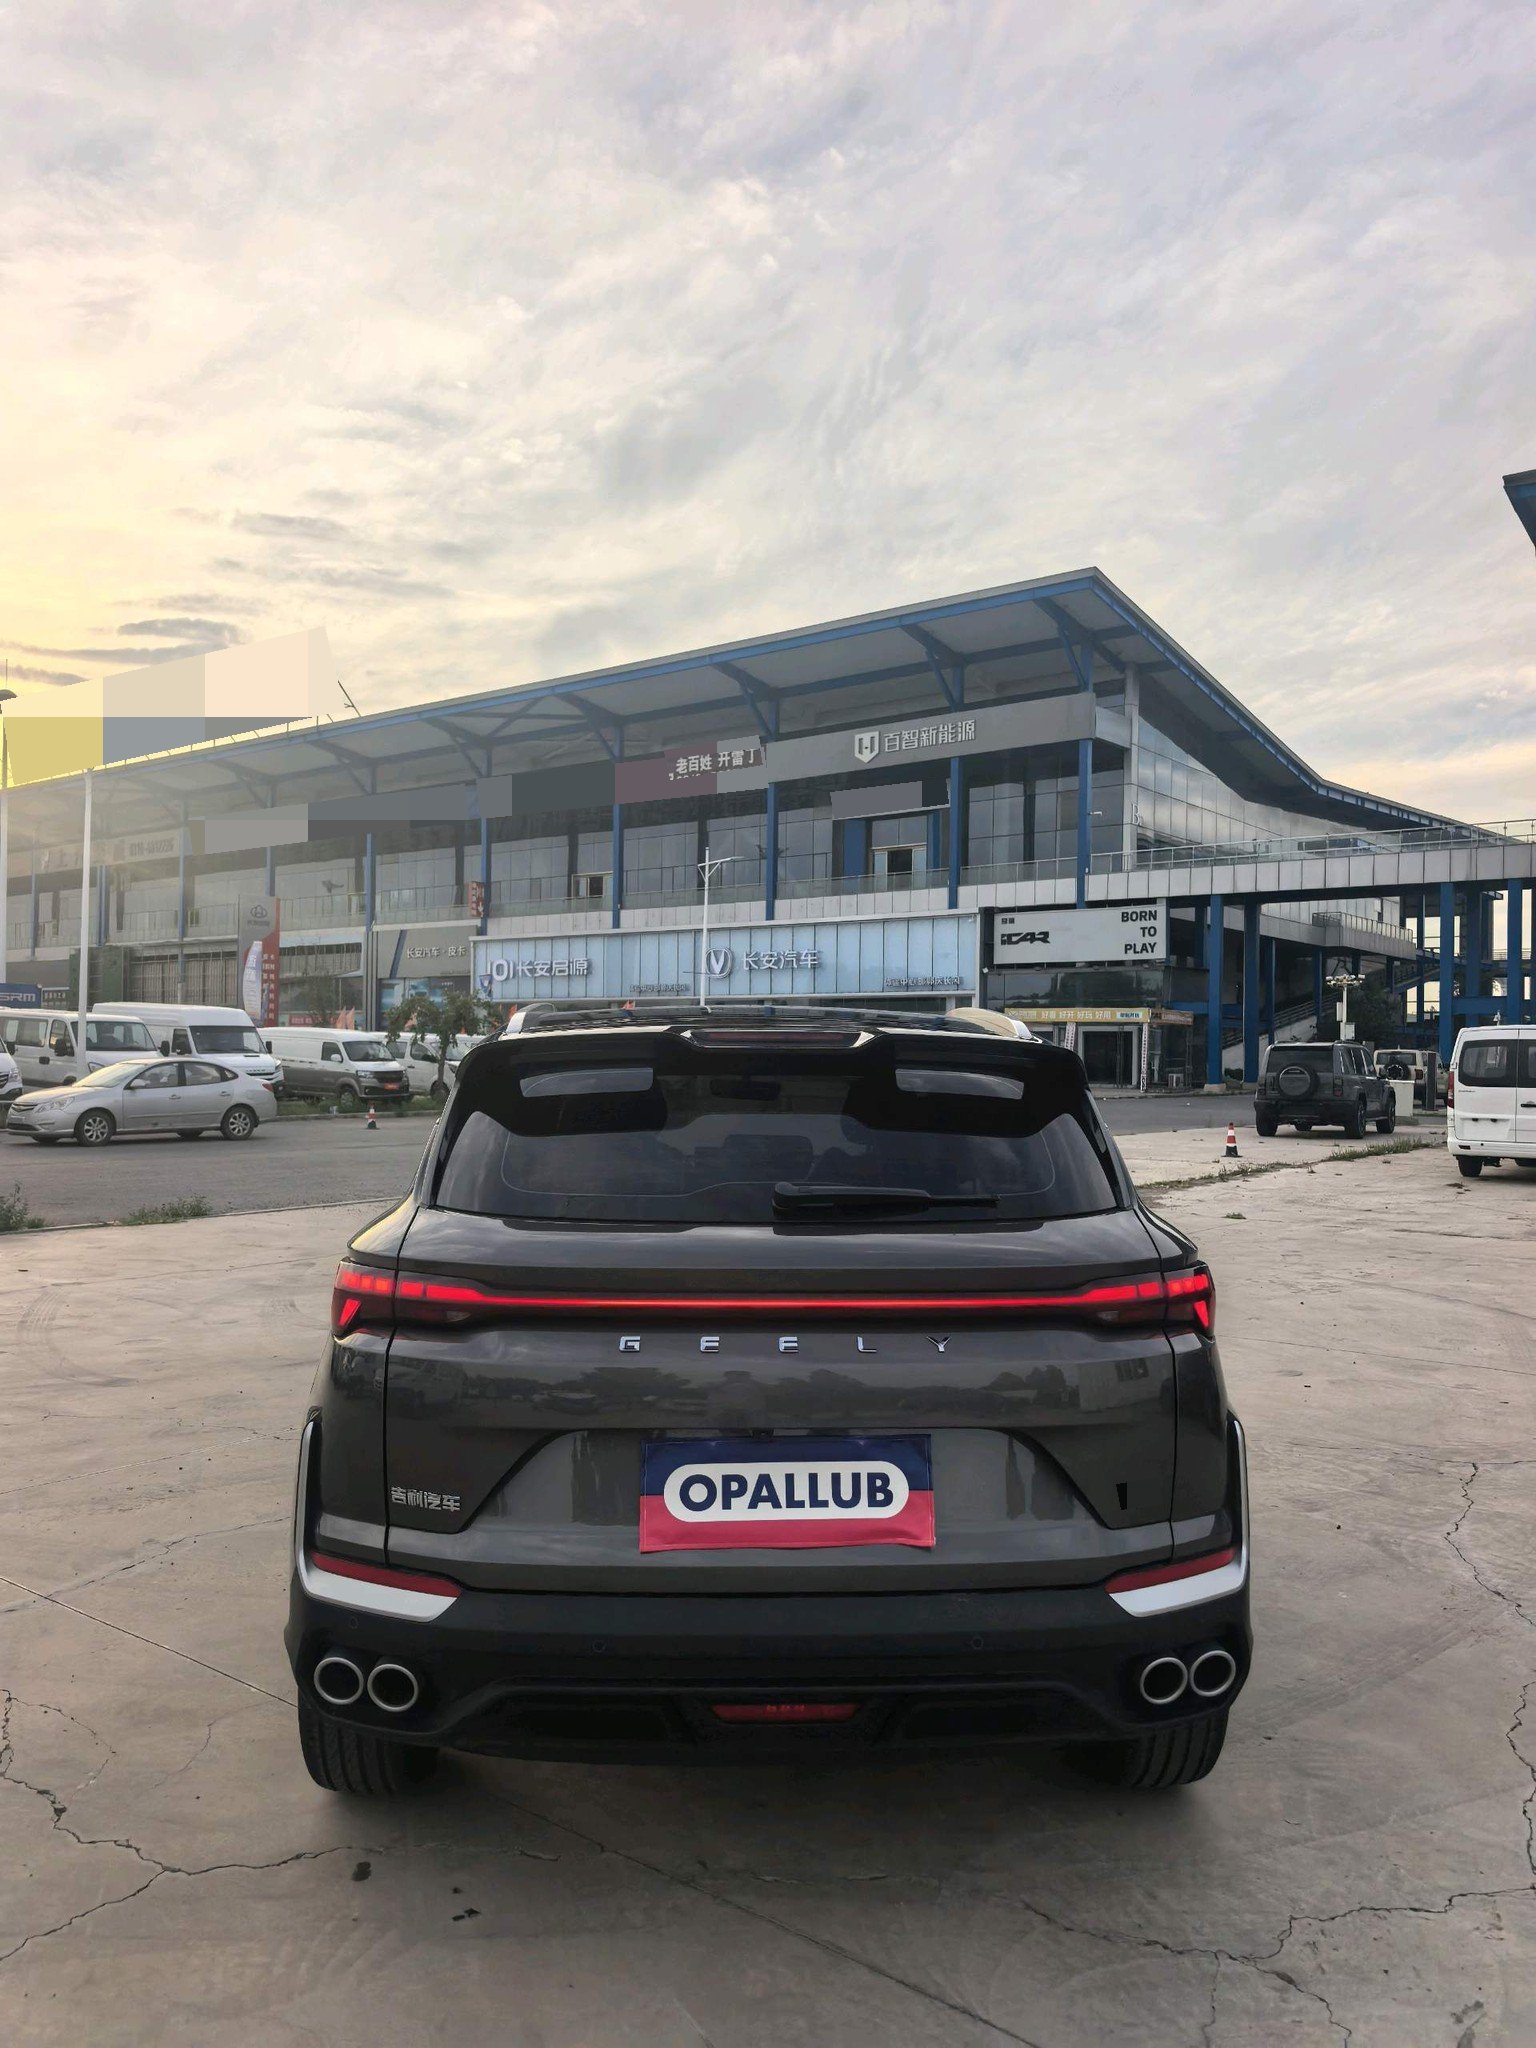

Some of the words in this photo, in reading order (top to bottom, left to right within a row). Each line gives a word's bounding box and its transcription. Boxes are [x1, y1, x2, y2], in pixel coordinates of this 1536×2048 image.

[883, 719, 976, 752] 百智新能源
[676, 754, 713, 774] 老百姓
[1121, 910, 1157, 922] BORN
[1140, 926, 1157, 937] TO
[1124, 942, 1157, 954] PLAY
[516, 957, 588, 978] 长安启源
[741, 948, 819, 971] 长安汽车
[619, 1336, 950, 1352] GEELY
[391, 1486, 461, 1512] 吉利汽车
[679, 1472, 894, 1512] OPALLUB
